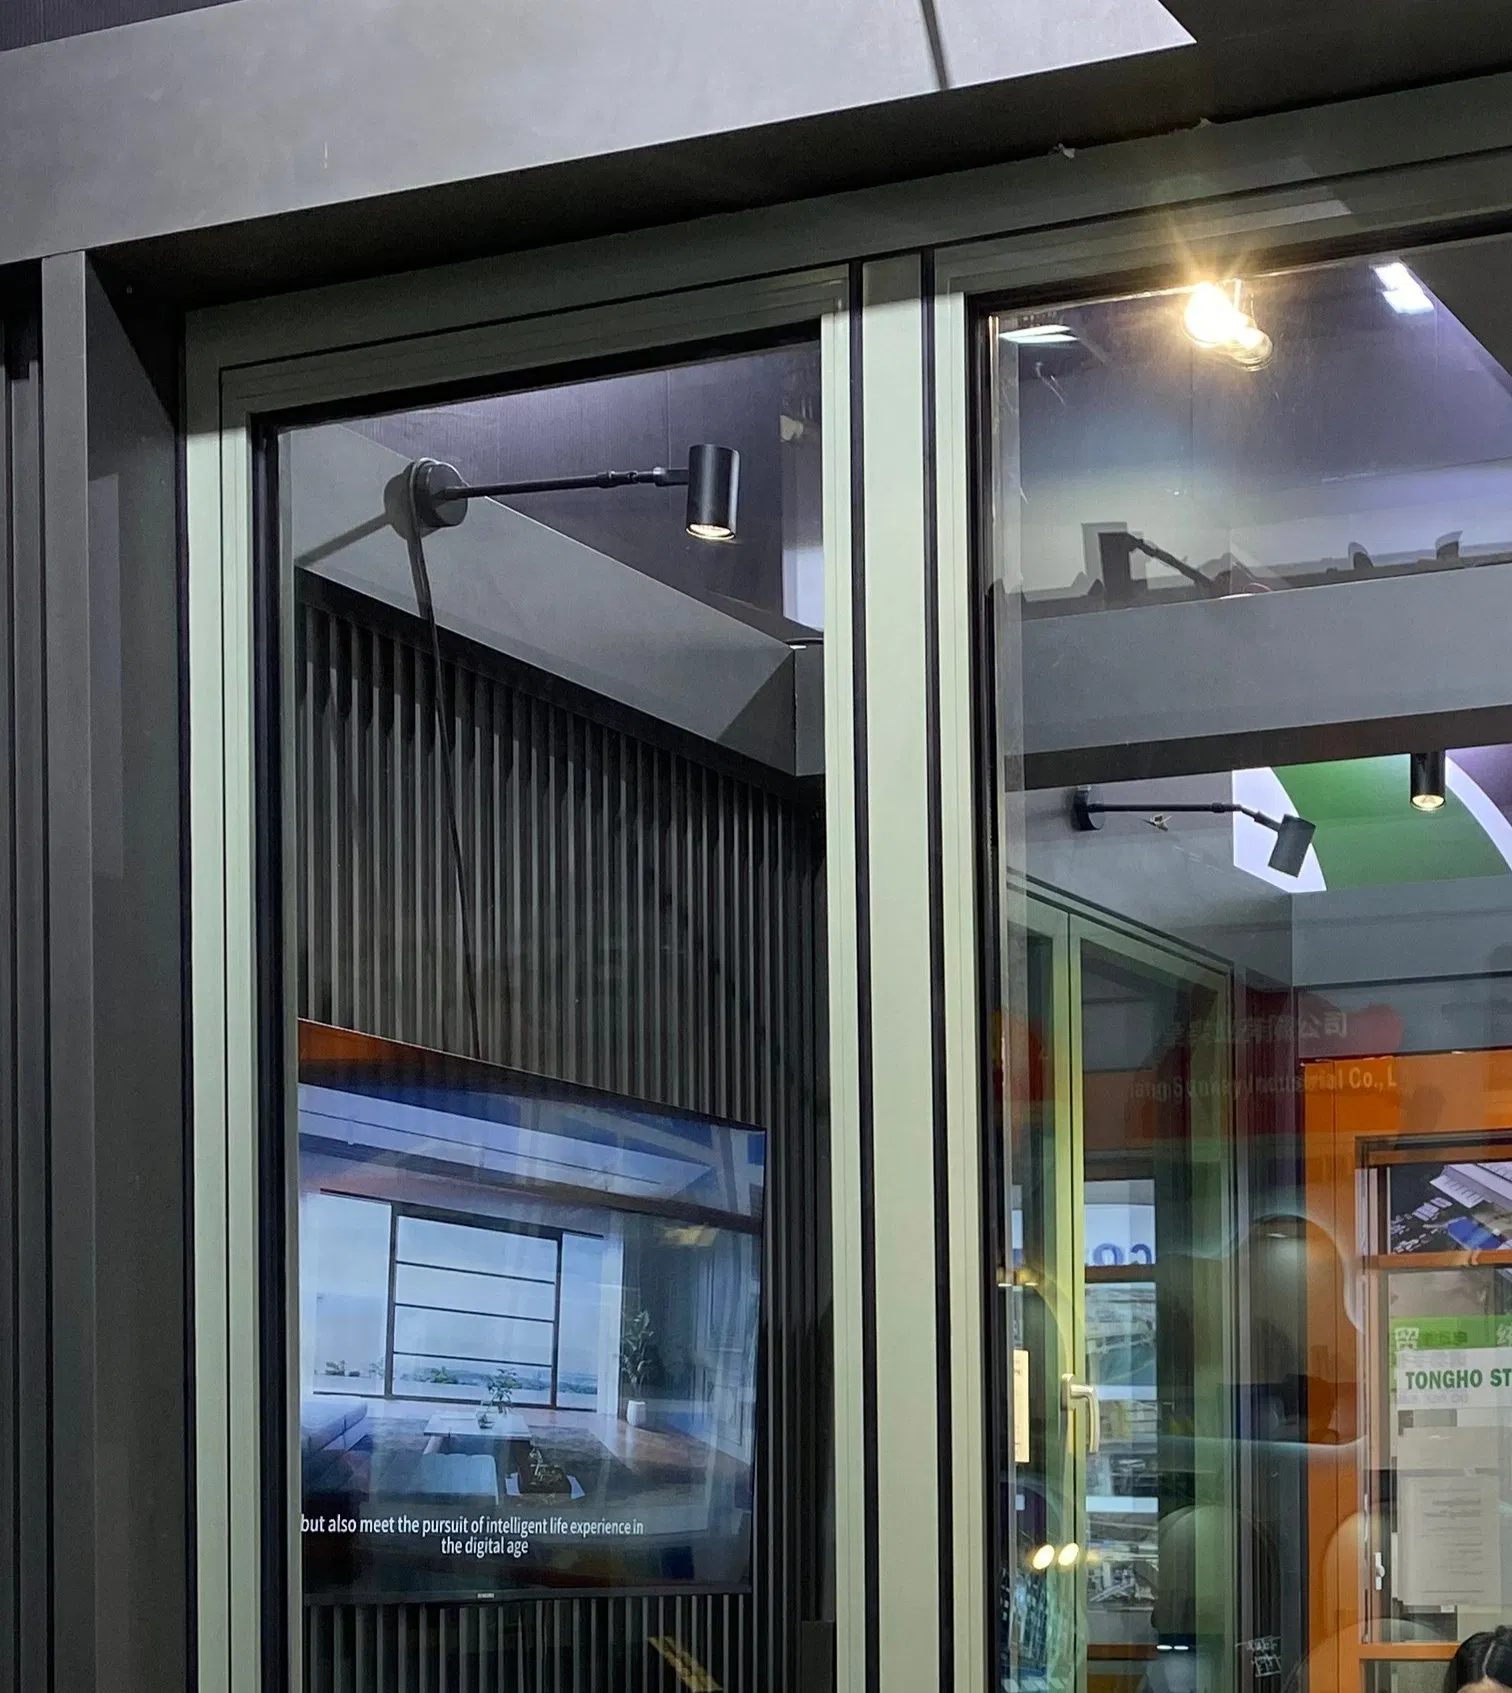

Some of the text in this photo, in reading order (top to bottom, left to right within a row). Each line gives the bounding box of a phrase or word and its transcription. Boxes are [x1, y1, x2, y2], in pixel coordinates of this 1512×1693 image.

[1405, 1369, 1483, 1390] TONGHO
[301, 1513, 644, 1538] but also meet the pursuit of intelligent life experience in
[441, 1536, 529, 1558] the digital age
